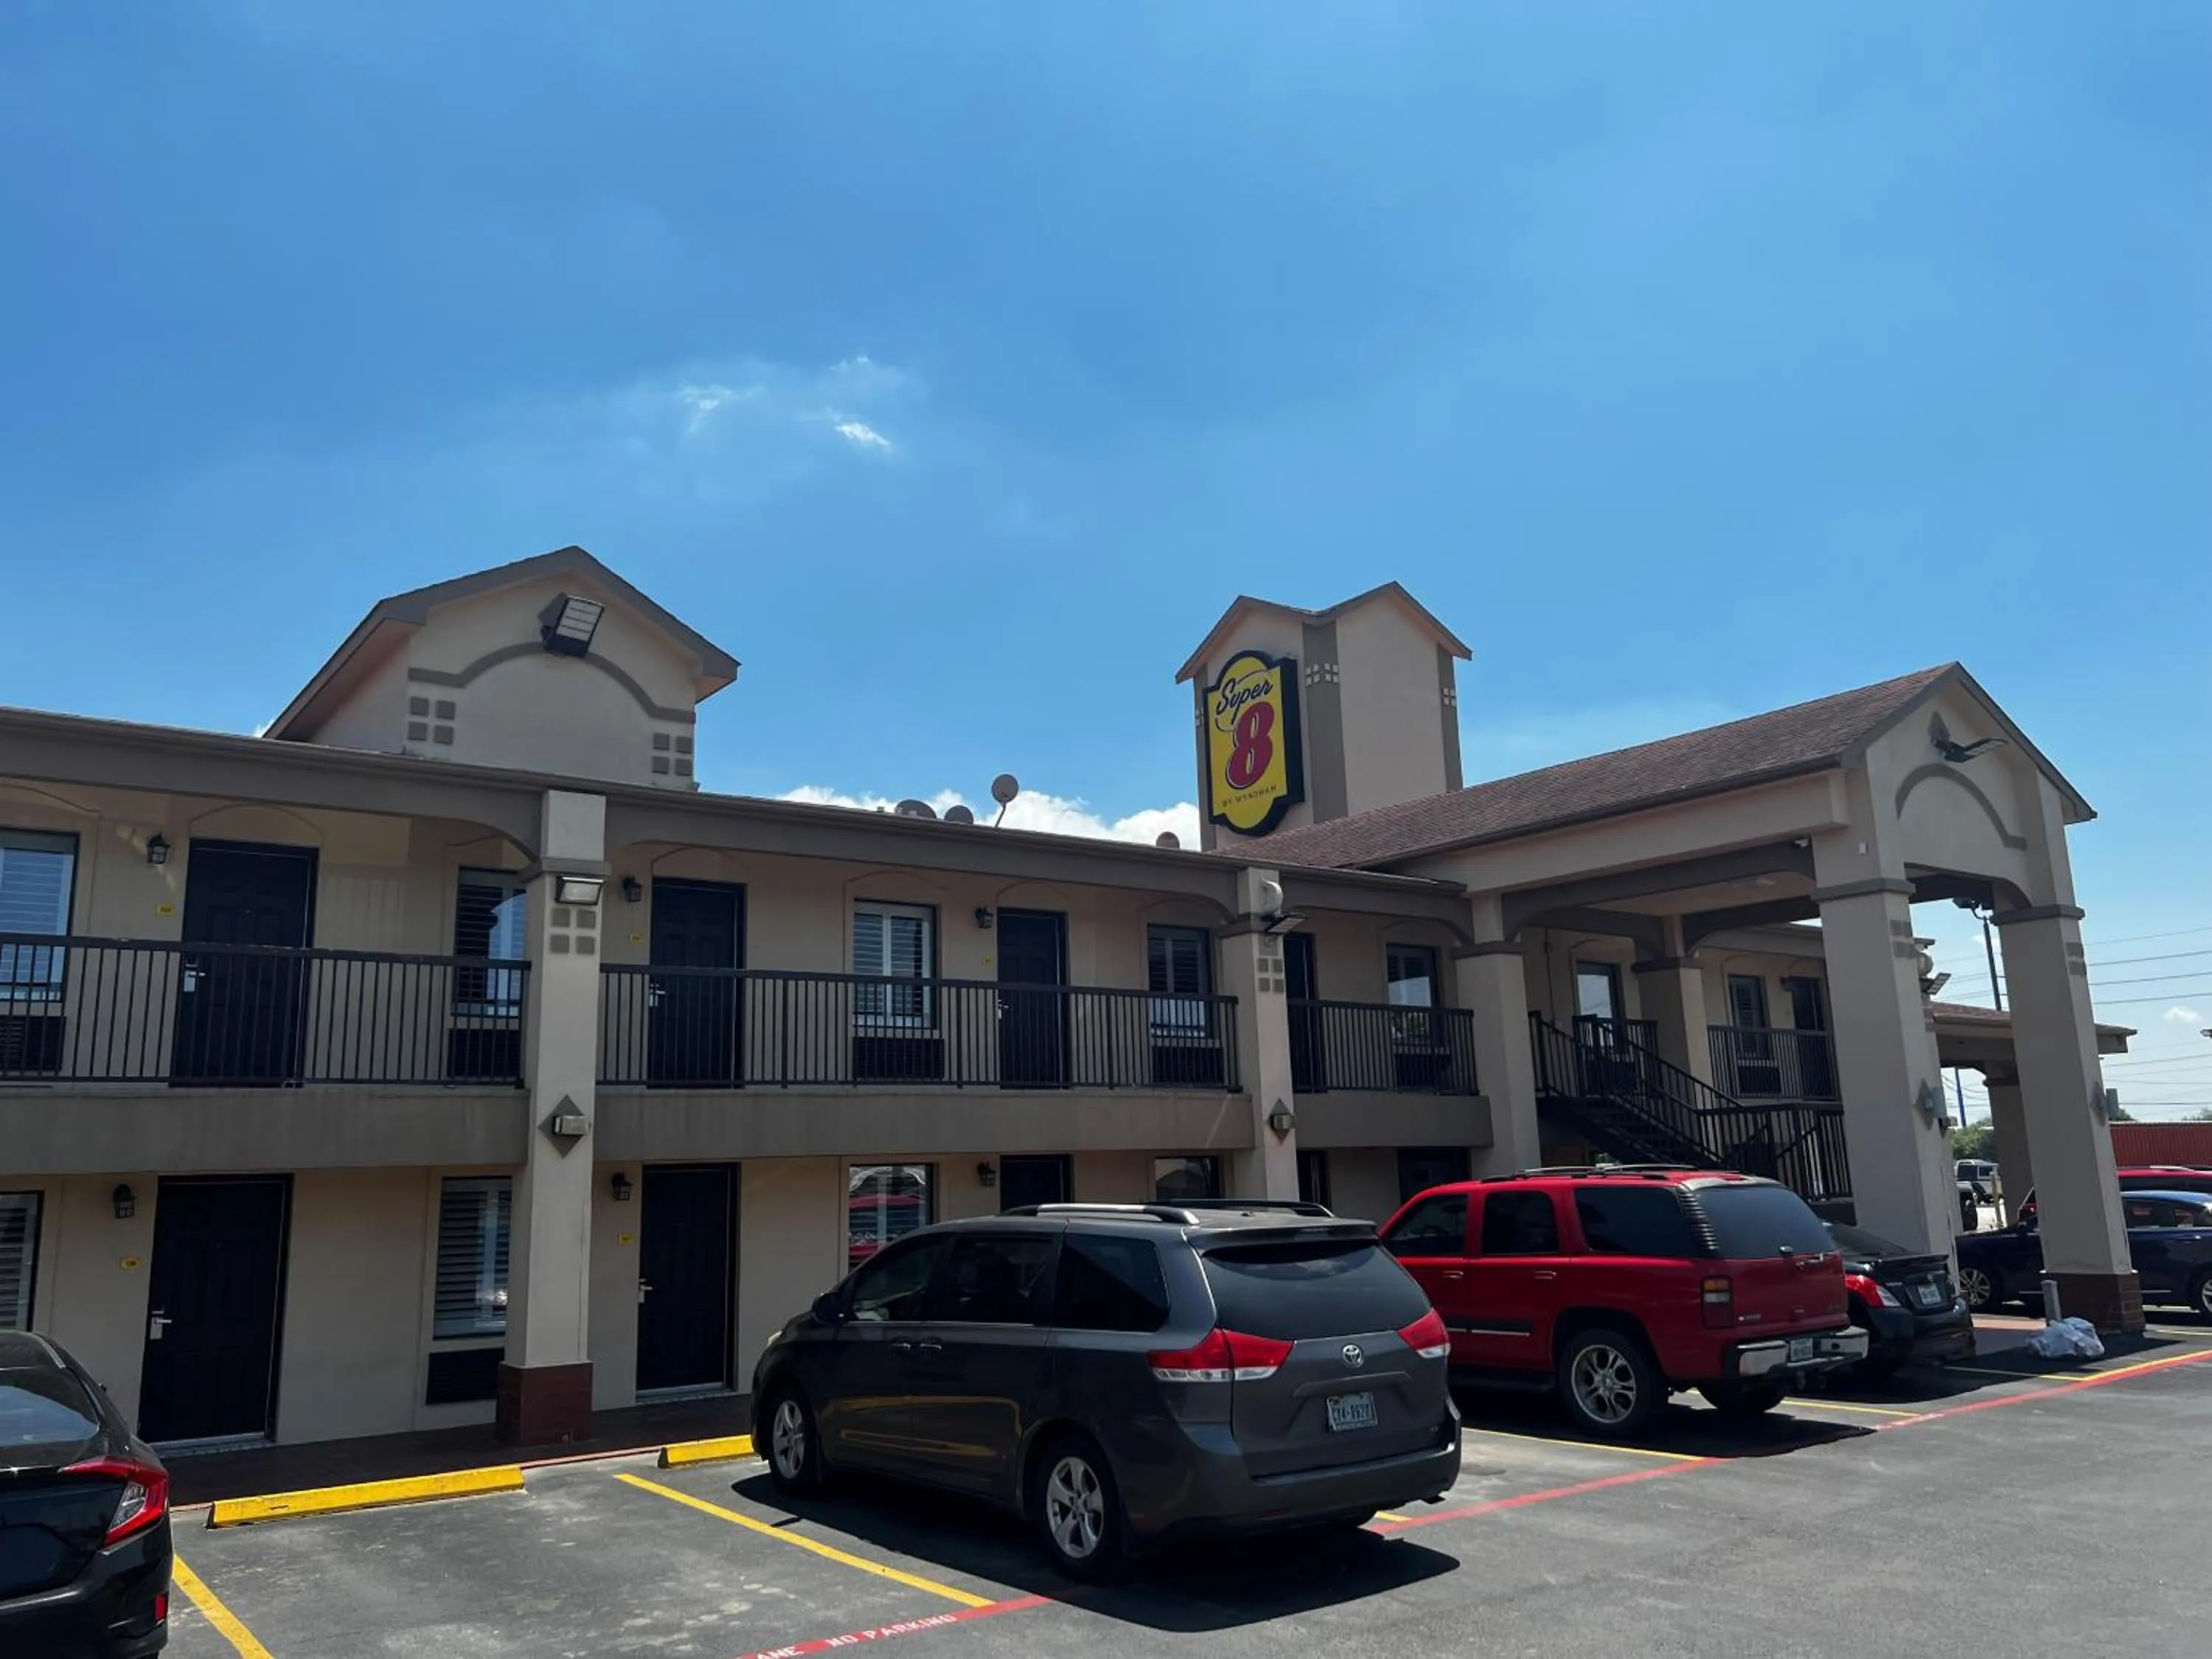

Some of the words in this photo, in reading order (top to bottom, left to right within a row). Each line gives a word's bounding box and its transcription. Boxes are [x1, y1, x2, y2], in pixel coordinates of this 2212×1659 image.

[1215, 677, 1273, 726] Super
[1225, 701, 1275, 790] 8
[755, 1646, 804, 1659] ANE
[824, 1635, 858, 1647] NO
[862, 1614, 958, 1639] PARKING
